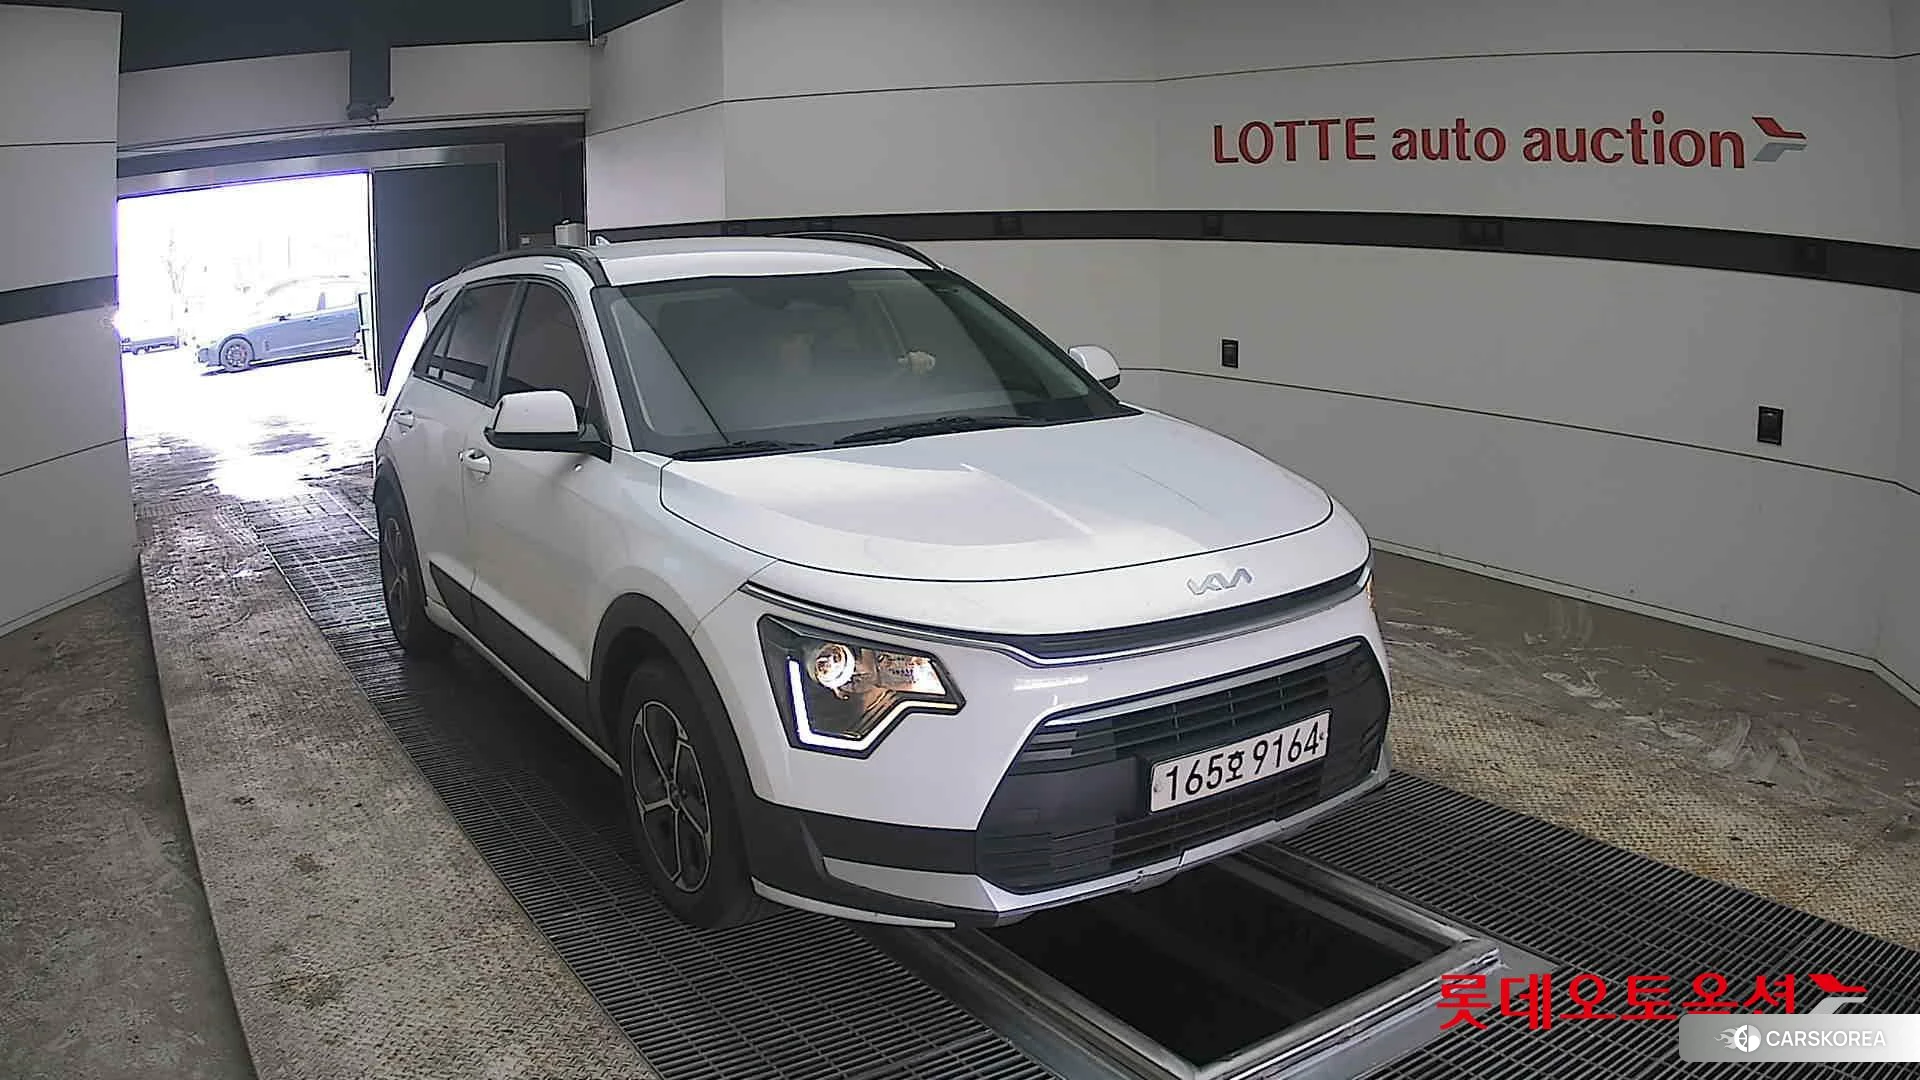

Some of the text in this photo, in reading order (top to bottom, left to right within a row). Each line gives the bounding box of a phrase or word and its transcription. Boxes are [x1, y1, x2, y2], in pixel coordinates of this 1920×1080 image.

[1213, 111, 1745, 169] LOTTE auto auction
[1165, 721, 1321, 801] 165호 9164
